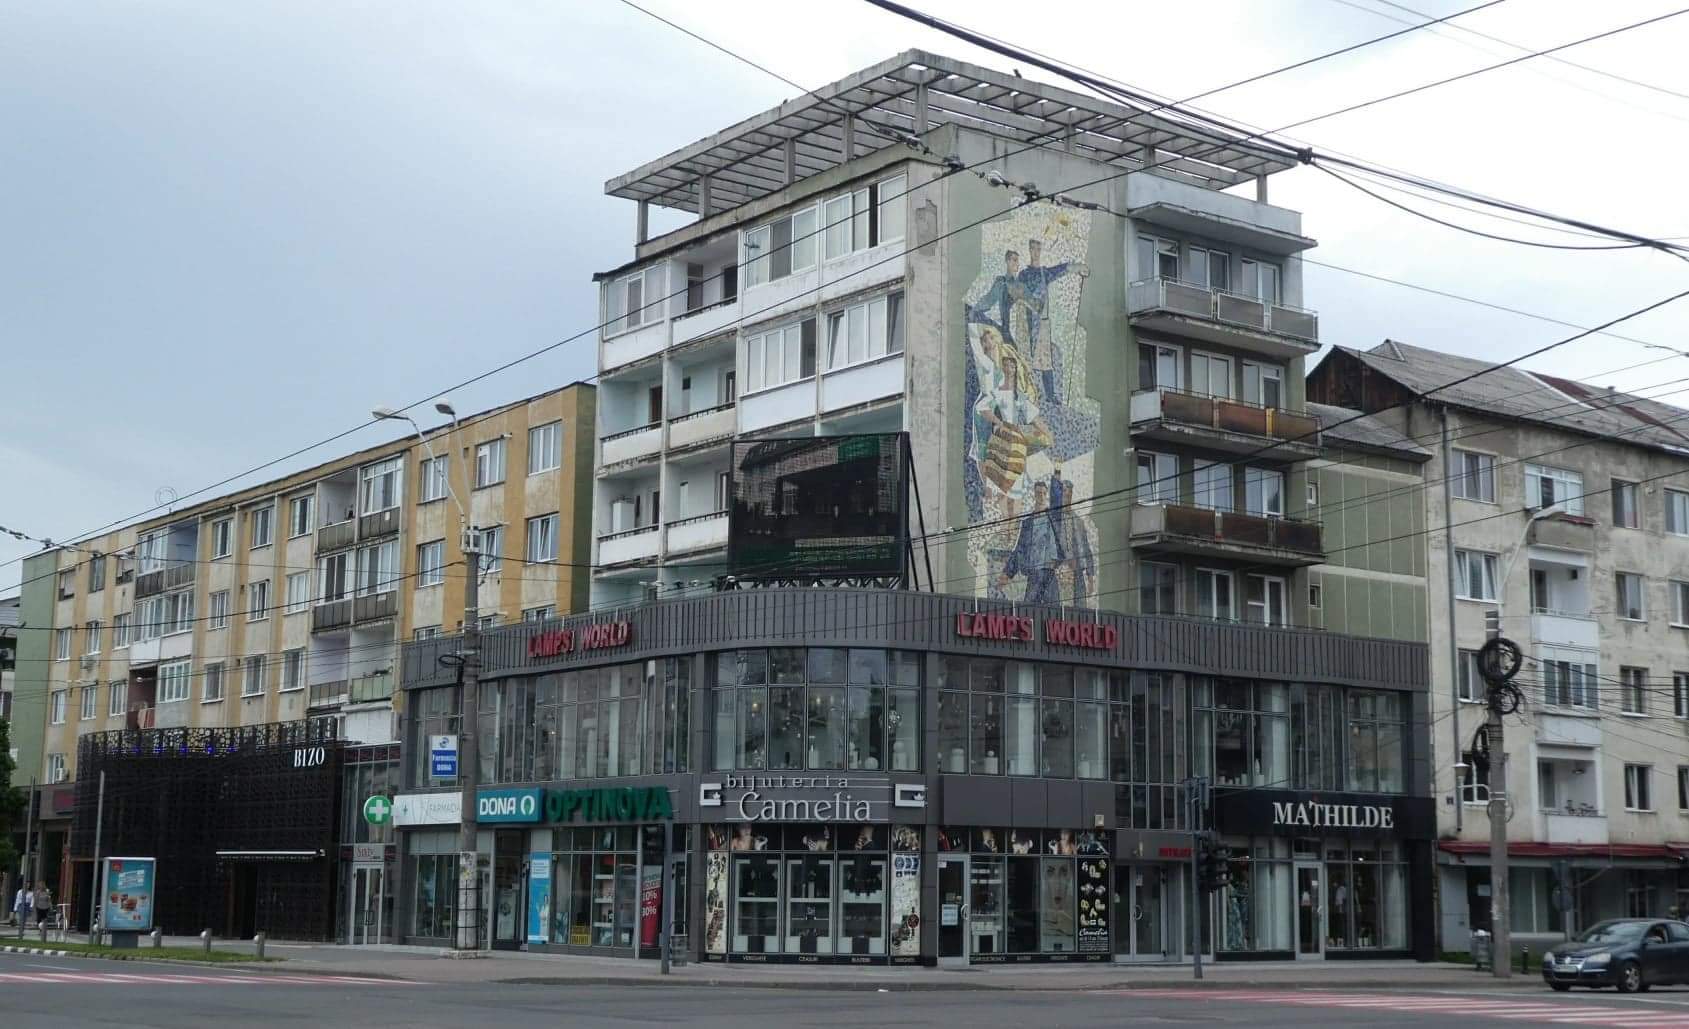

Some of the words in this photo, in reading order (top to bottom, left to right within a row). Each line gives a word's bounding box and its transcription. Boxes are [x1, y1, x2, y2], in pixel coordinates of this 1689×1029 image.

[527, 630, 576, 658] LAMPS
[580, 621, 632, 651] WORLD
[957, 612, 1034, 641] LAMPS
[1046, 618, 1119, 649] WORLD
[294, 746, 325, 768] BIZO
[726, 774, 848, 791] bijuteria
[479, 796, 516, 816] DONA
[546, 786, 672, 822] OPTINOVA
[739, 791, 871, 822] Camelia
[1272, 800, 1394, 829] MATHILDE
